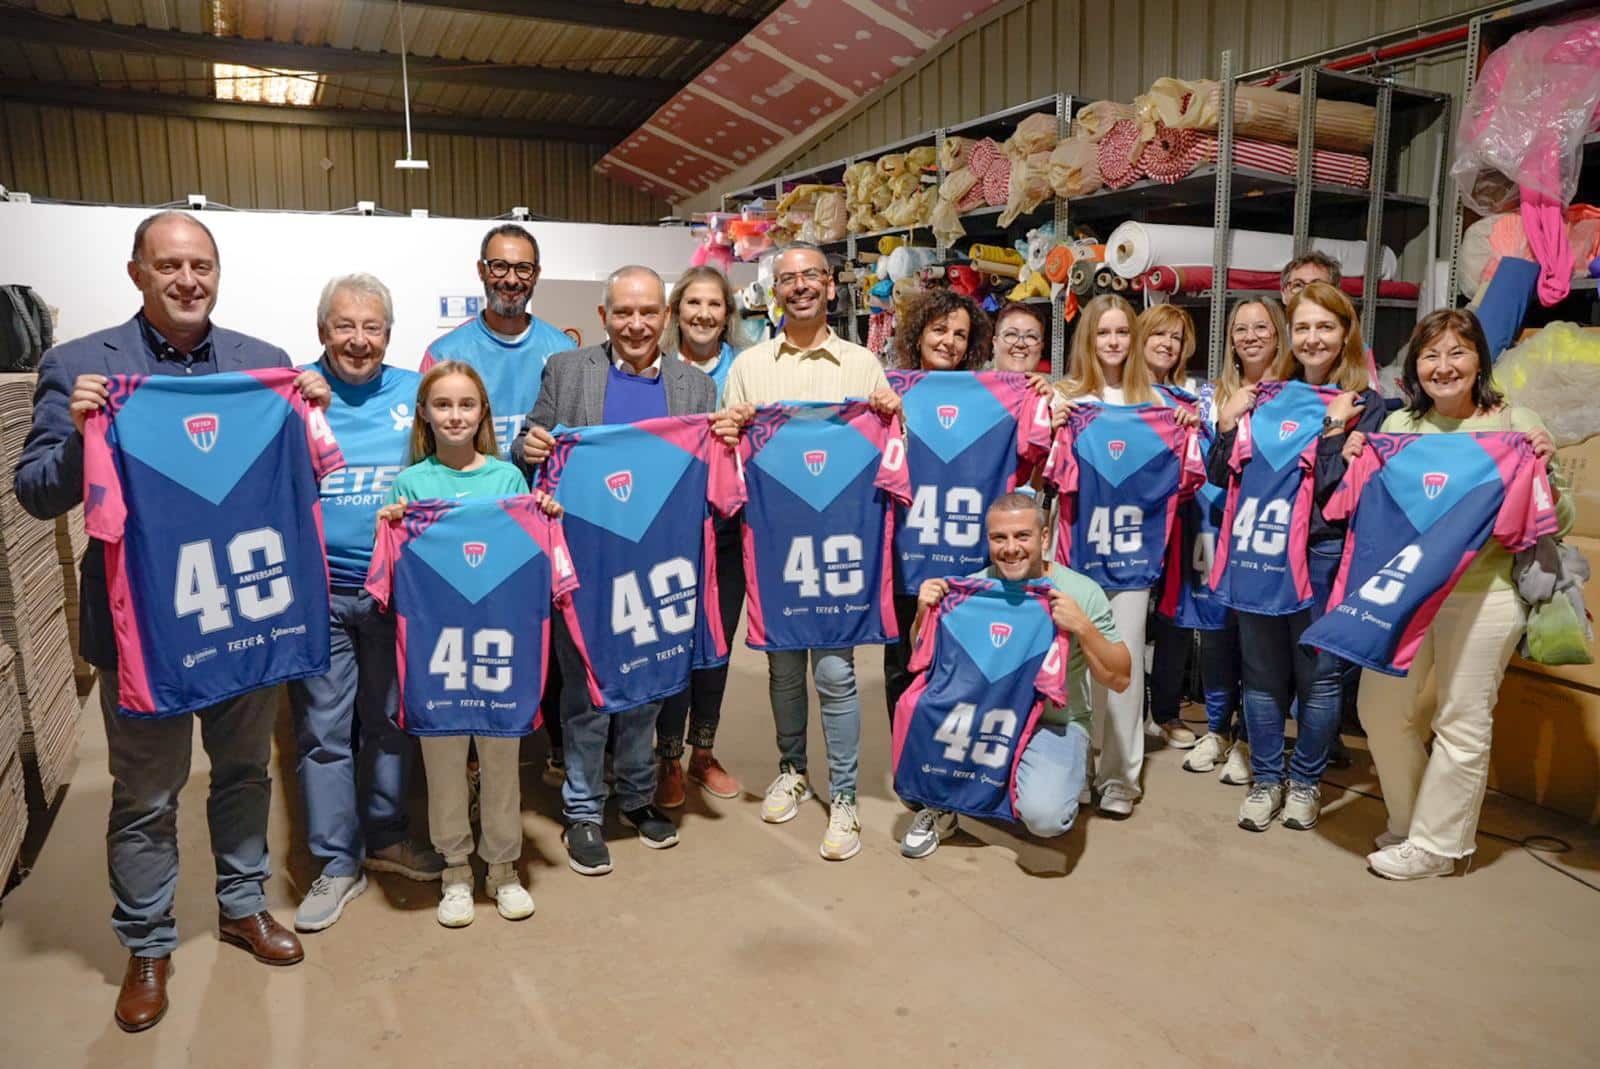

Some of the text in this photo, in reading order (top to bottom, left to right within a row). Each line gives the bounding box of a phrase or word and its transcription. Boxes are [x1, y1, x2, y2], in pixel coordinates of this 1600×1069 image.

[309, 407, 336, 445] 4
[884, 440, 902, 472] 0
[905, 485, 983, 547] 40
[1087, 505, 1144, 556] 40
[1231, 496, 1291, 556] 40
[175, 526, 295, 636] 40
[554, 547, 573, 578] 4
[783, 534, 865, 598] 40
[611, 556, 698, 648] 40
[429, 626, 514, 693] 40
[934, 701, 1019, 770] 40
